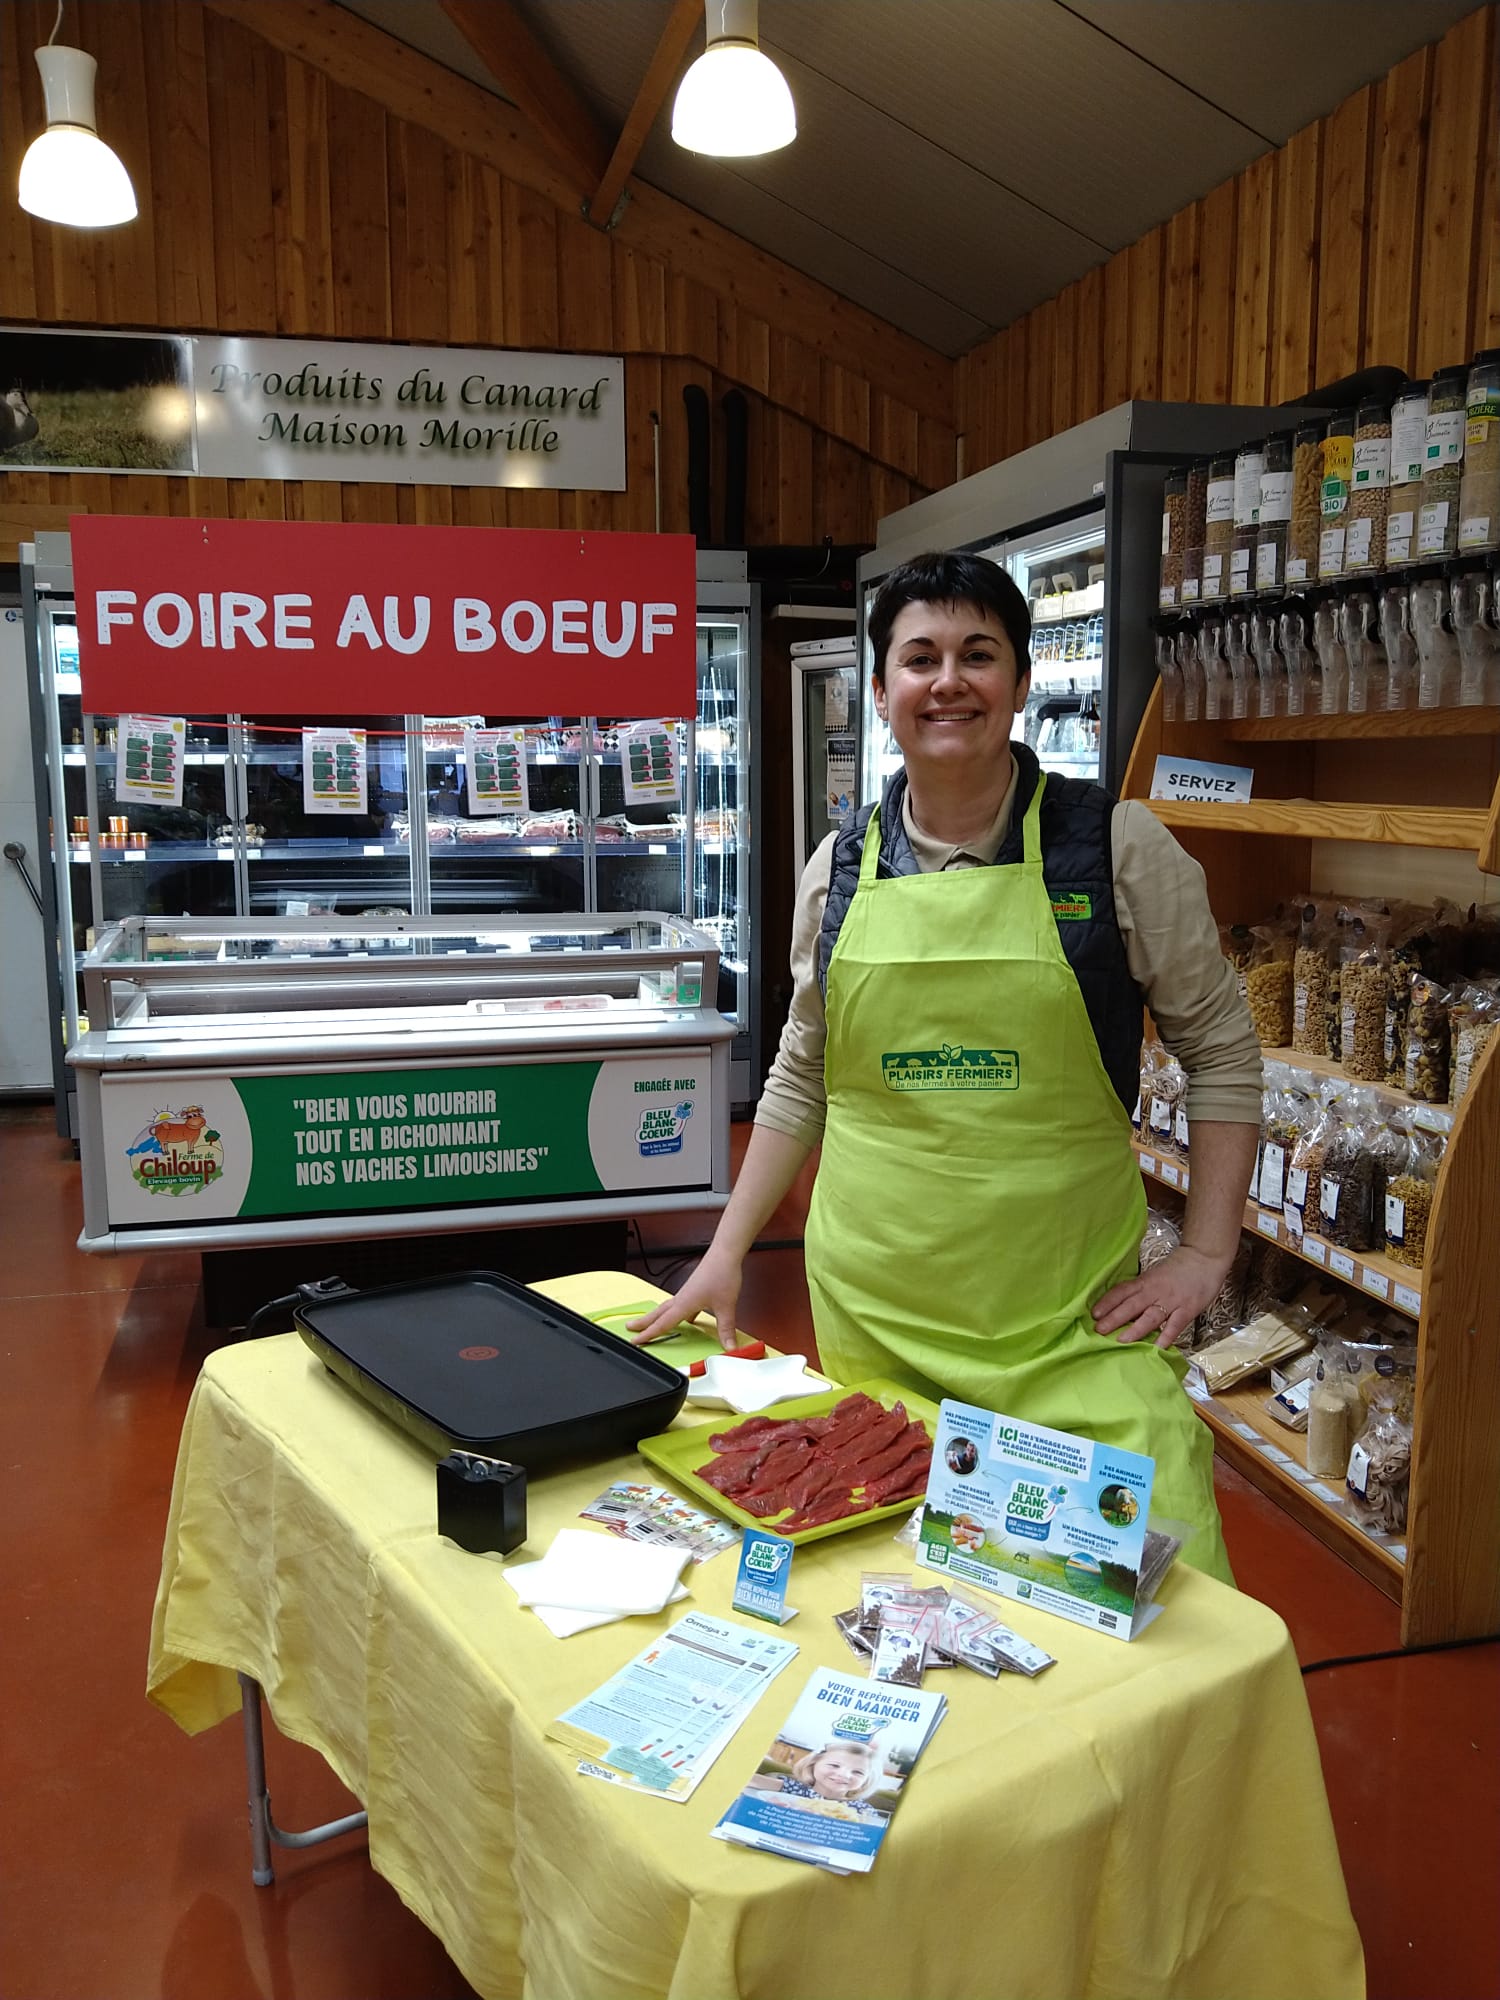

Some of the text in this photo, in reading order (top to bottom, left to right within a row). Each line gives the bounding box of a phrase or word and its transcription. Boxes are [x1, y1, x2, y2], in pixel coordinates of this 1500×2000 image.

[211, 363, 609, 410] Produits du Canard
[258, 412, 558, 451] Maison Morille
[95, 590, 677, 658] FOIRE AU BOEUF
[1168, 773, 1236, 793] SERVEZ
[634, 1077, 696, 1092] ENGAGÉE AVEC
[888, 1068, 1013, 1081] PLAISIRS FERMIERS
[921, 1080, 949, 1088] fermes
[978, 1080, 1003, 1088] panier
[293, 1090, 496, 1123] "BIEN VOUS NOURRIR
[646, 1110, 671, 1121] BLEU
[642, 1118, 677, 1129] BLANC
[294, 1119, 501, 1155] TOUT EN BICHONNANT
[140, 1149, 216, 1184] Chiloup
[178, 1152, 203, 1160] Ferme
[296, 1147, 549, 1186] NOS VACHES LIMOUSINES"
[998, 1426, 1080, 1454] ICI ON S'ENGAGE POUR
[1018, 1438, 1031, 1446] UNE
[1032, 1442, 1077, 1460] ALIMENTATION
[996, 1439, 1087, 1470] UNE AGRICULTURE DURABLES
[1002, 1447, 1017, 1456] AVEC
[1011, 1489, 1049, 1512] BLANC
[1017, 1480, 1044, 1499] BLEU
[751, 1550, 776, 1562] BLANC
[755, 1543, 774, 1553] BLEU
[685, 1617, 720, 1634] Omega
[816, 1688, 920, 1723] BIEN MANGER
[827, 1680, 920, 1710] VOTRE REPÈRE POUR
